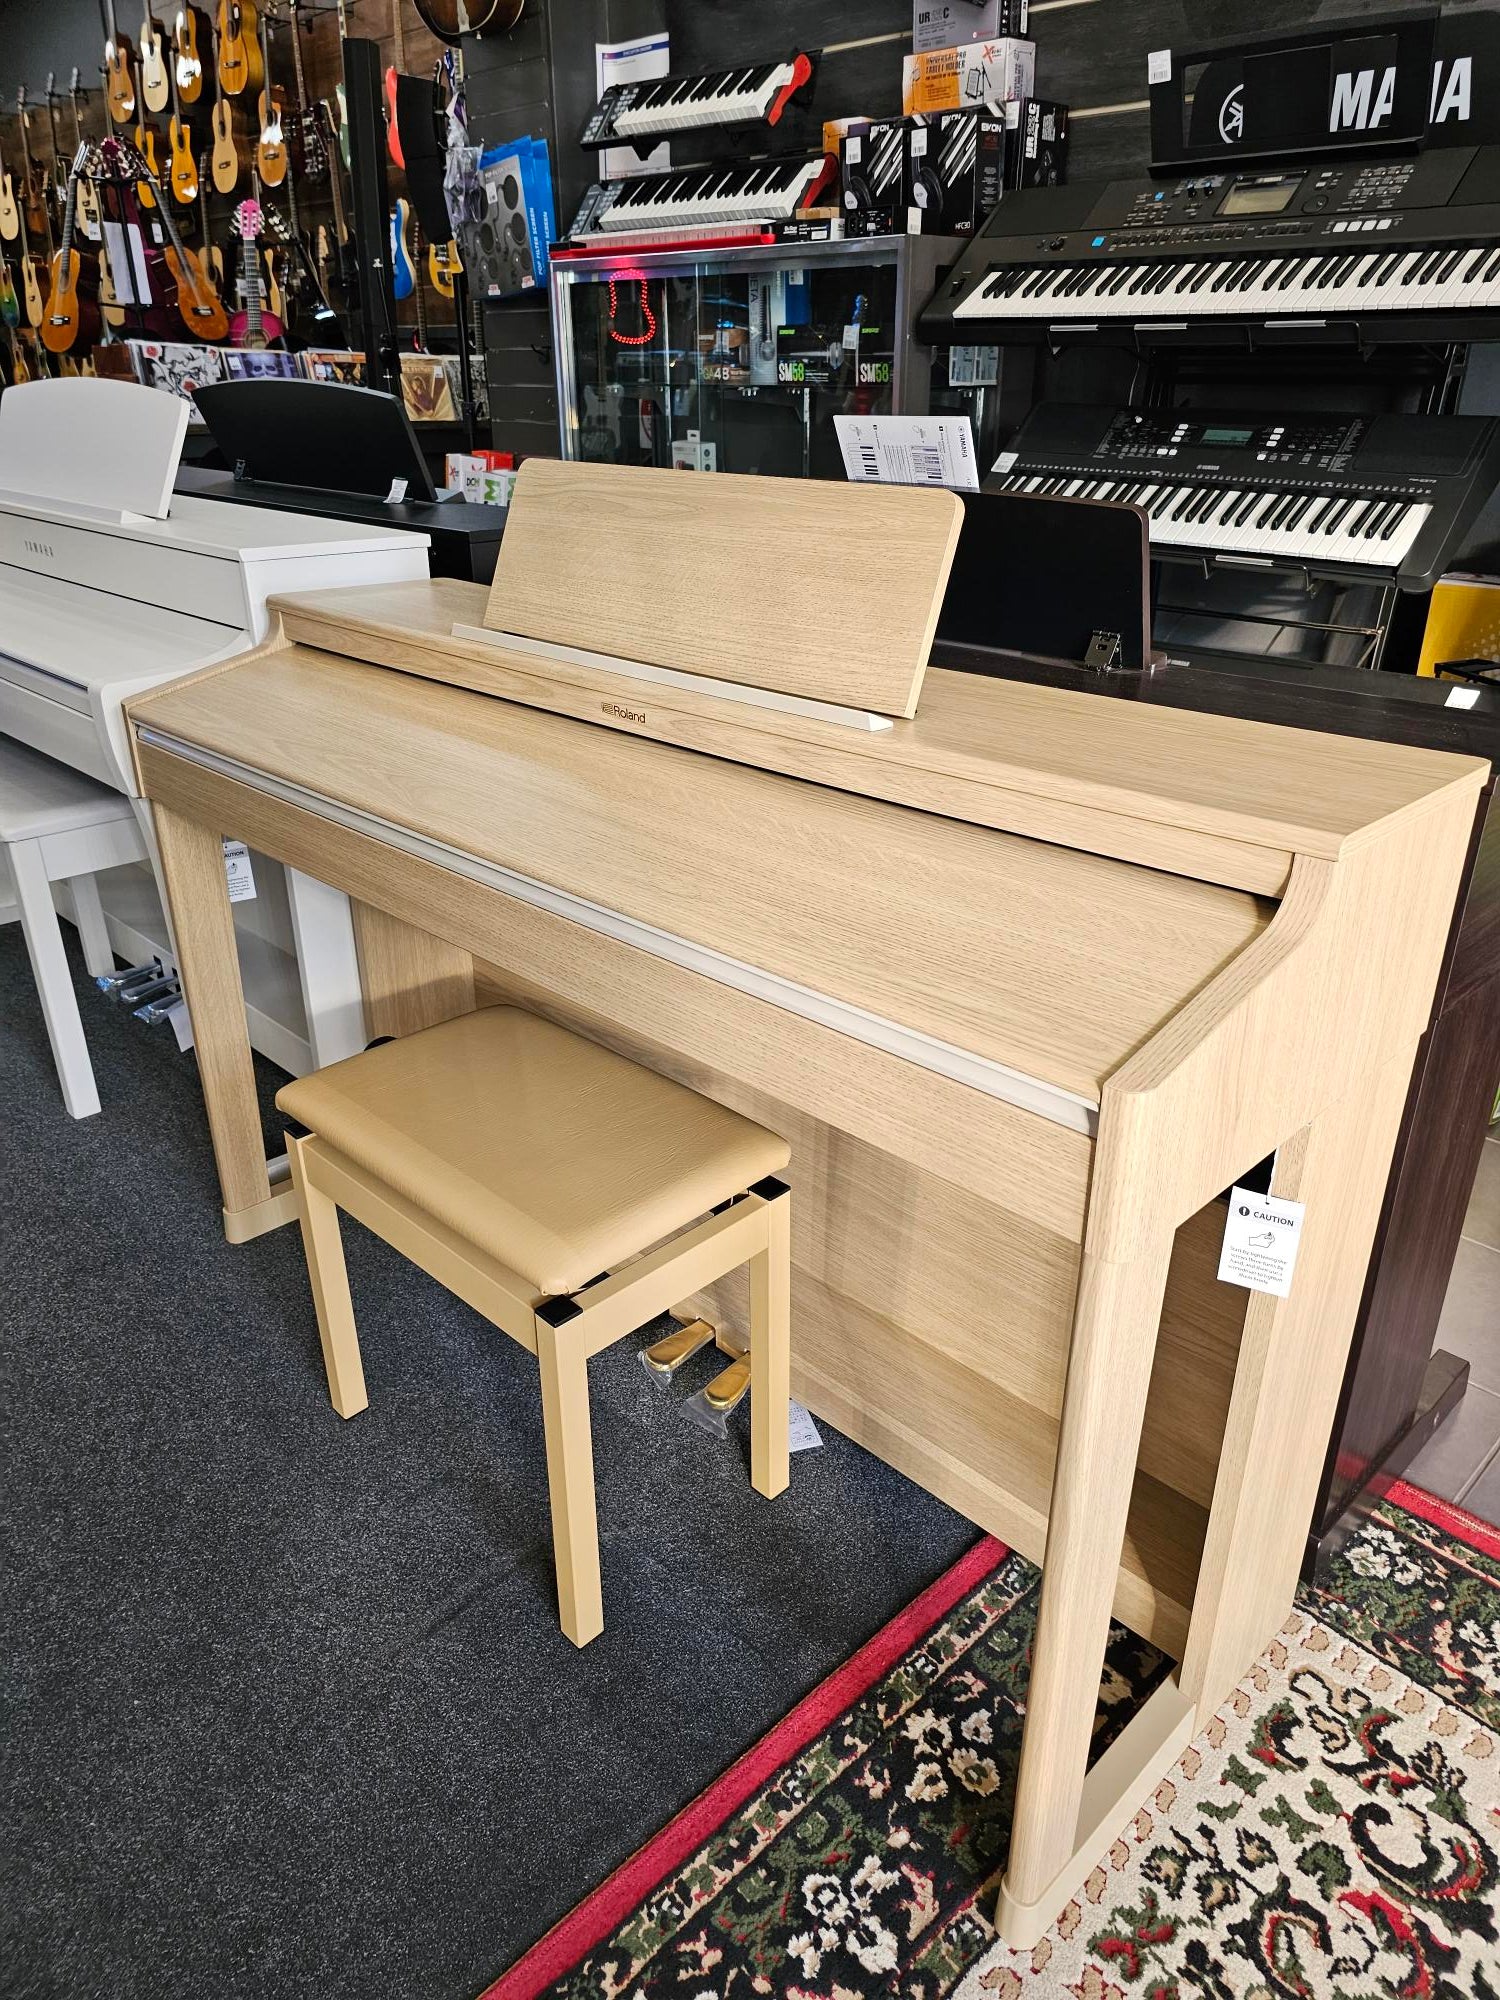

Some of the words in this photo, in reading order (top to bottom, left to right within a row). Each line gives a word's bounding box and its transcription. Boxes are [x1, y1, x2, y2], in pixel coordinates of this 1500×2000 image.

[530, 207, 538, 234] SCREEN
[779, 362, 805, 382] SM58
[860, 362, 891, 383] SM58
[959, 434, 968, 458] YAMAHA
[24, 540, 54, 558] YAMAHA
[613, 704, 646, 724] Roland
[224, 850, 244, 858] AUTION
[1253, 1211, 1294, 1227] CAUTION
